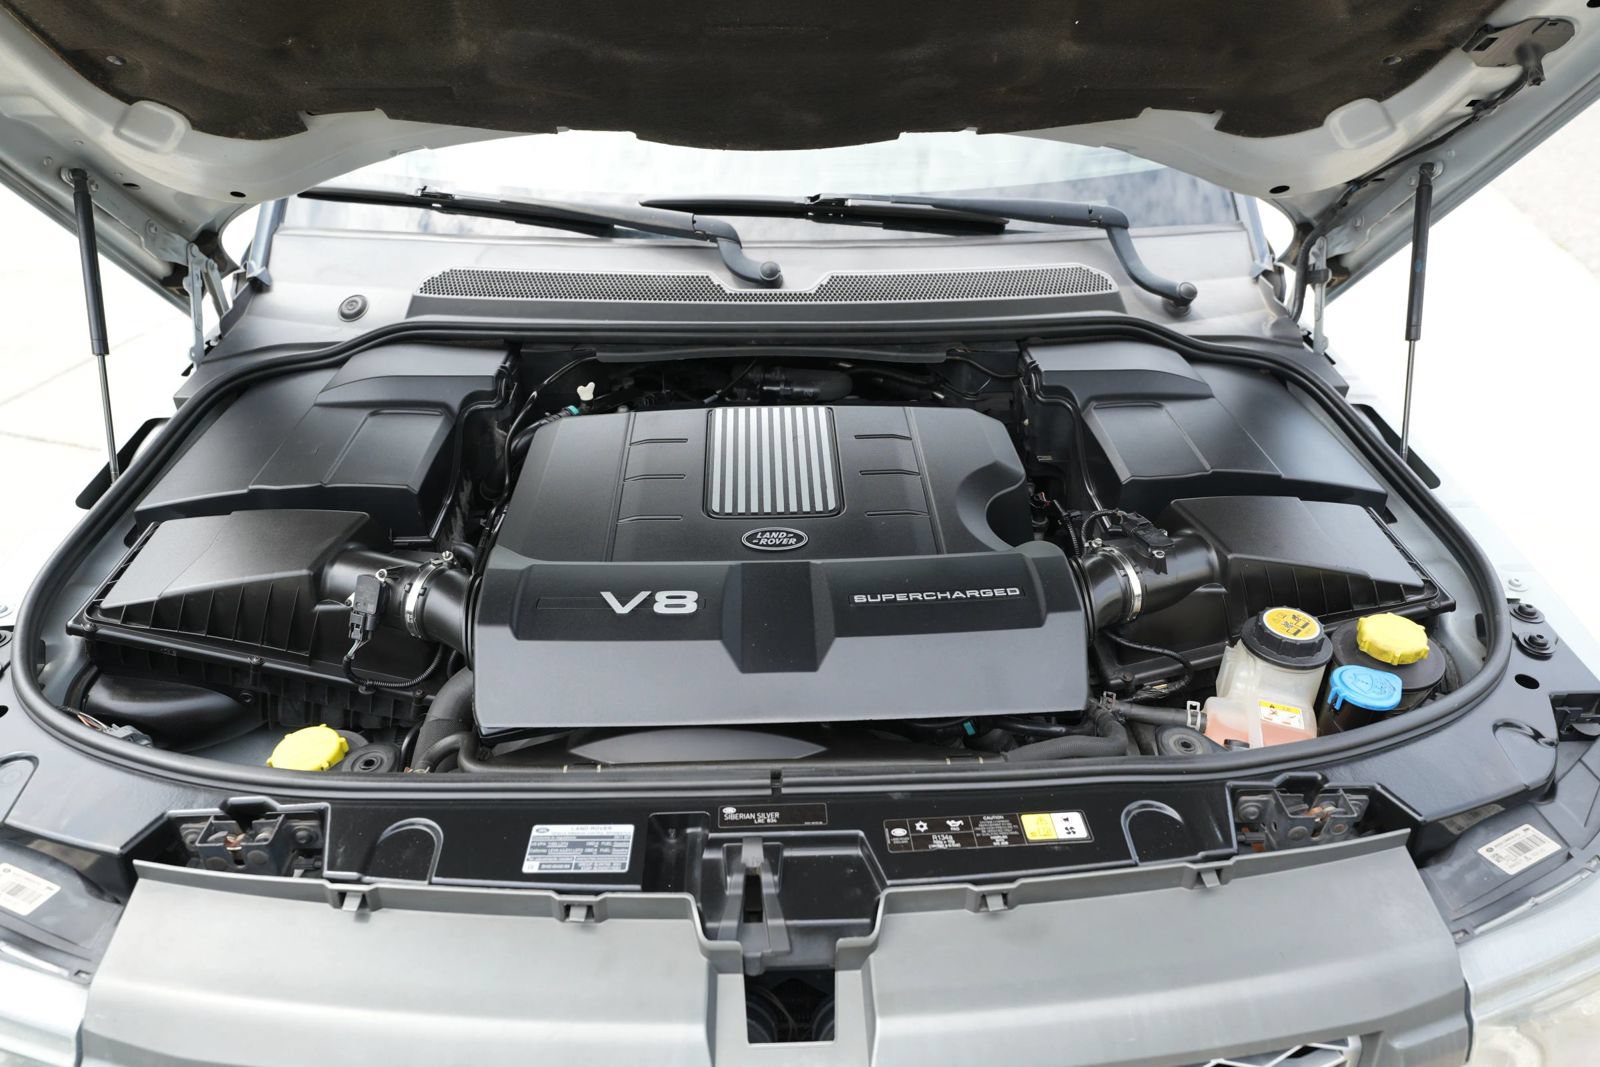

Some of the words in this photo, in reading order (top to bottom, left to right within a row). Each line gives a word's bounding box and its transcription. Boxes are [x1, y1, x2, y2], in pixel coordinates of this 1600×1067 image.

[756, 531, 788, 539] LAND
[759, 537, 797, 545] ROVER
[853, 586, 1021, 604] SUPERCHARGED
[599, 590, 699, 614] V8
[723, 812, 755, 820] SIBERIAN
